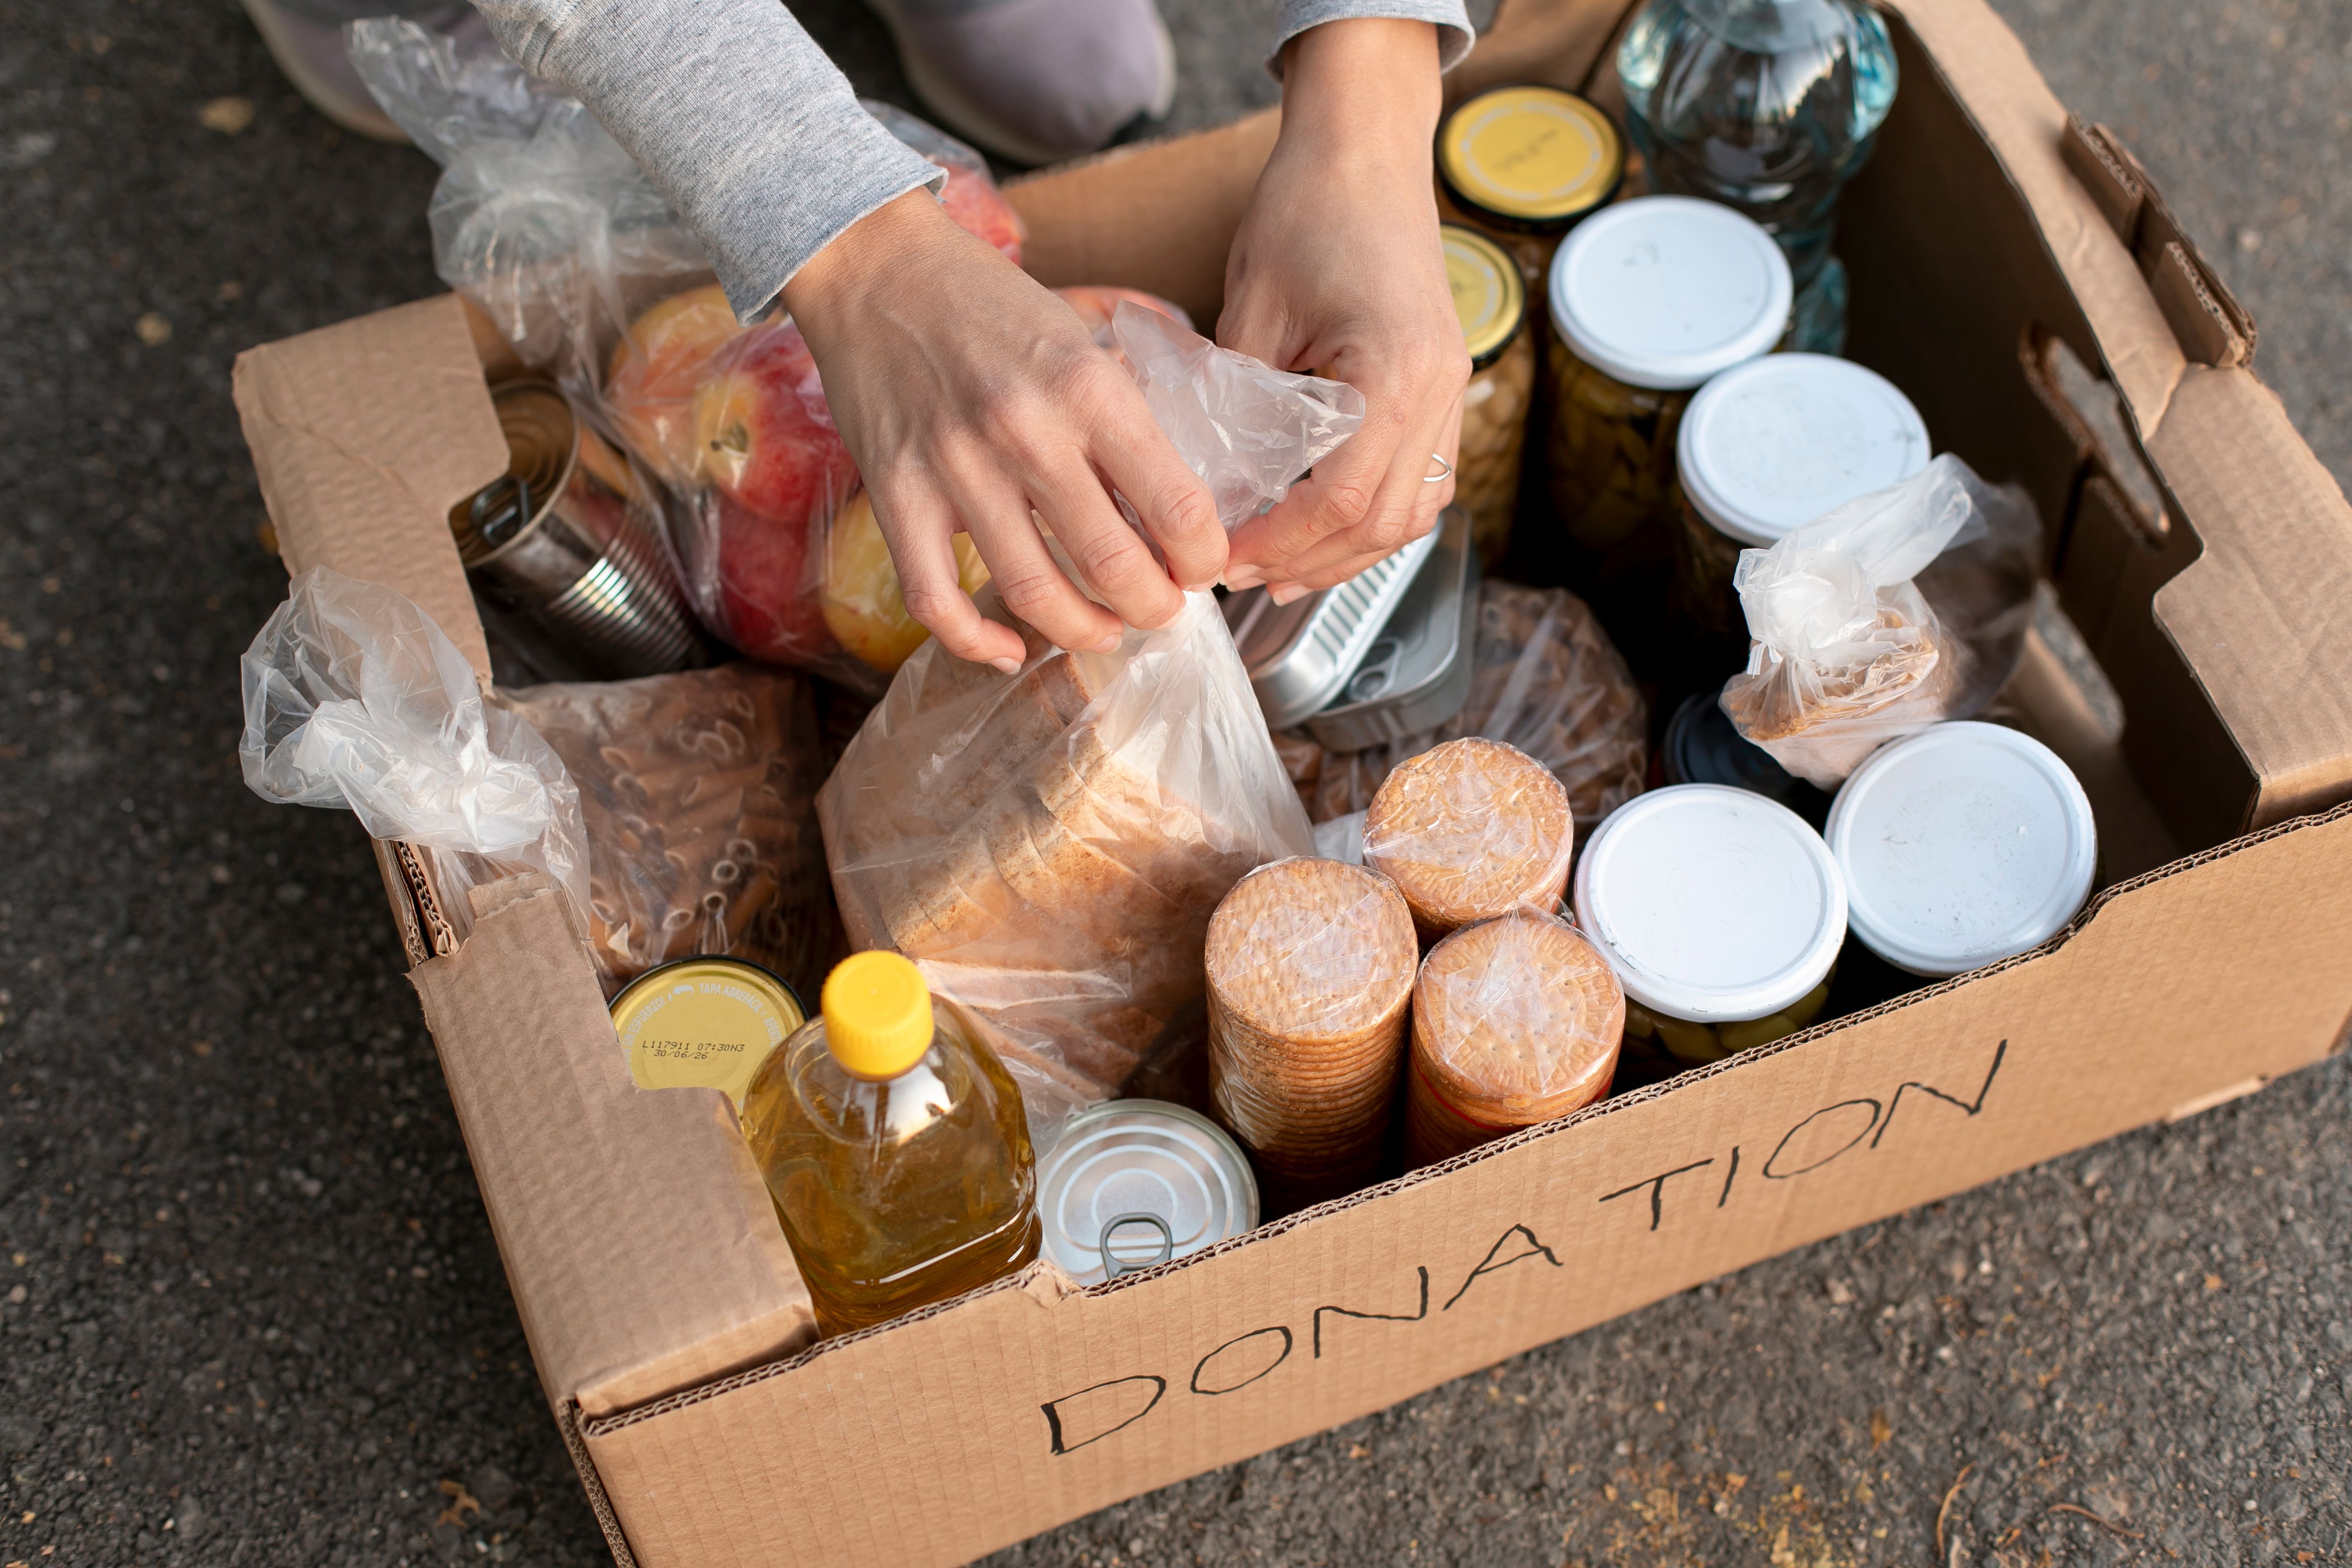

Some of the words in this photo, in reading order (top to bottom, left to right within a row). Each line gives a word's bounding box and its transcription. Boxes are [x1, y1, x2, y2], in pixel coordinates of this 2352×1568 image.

[699, 983, 721, 994] TAPA
[722, 985, 764, 1013] ABREFÁCIL
[627, 995, 666, 1035] ESFUERZO!
[621, 1032, 636, 1047] SIN
[642, 1040, 689, 1050] L117911
[697, 1043, 745, 1052] 07:30N3
[653, 1049, 708, 1059] 30/06/26
